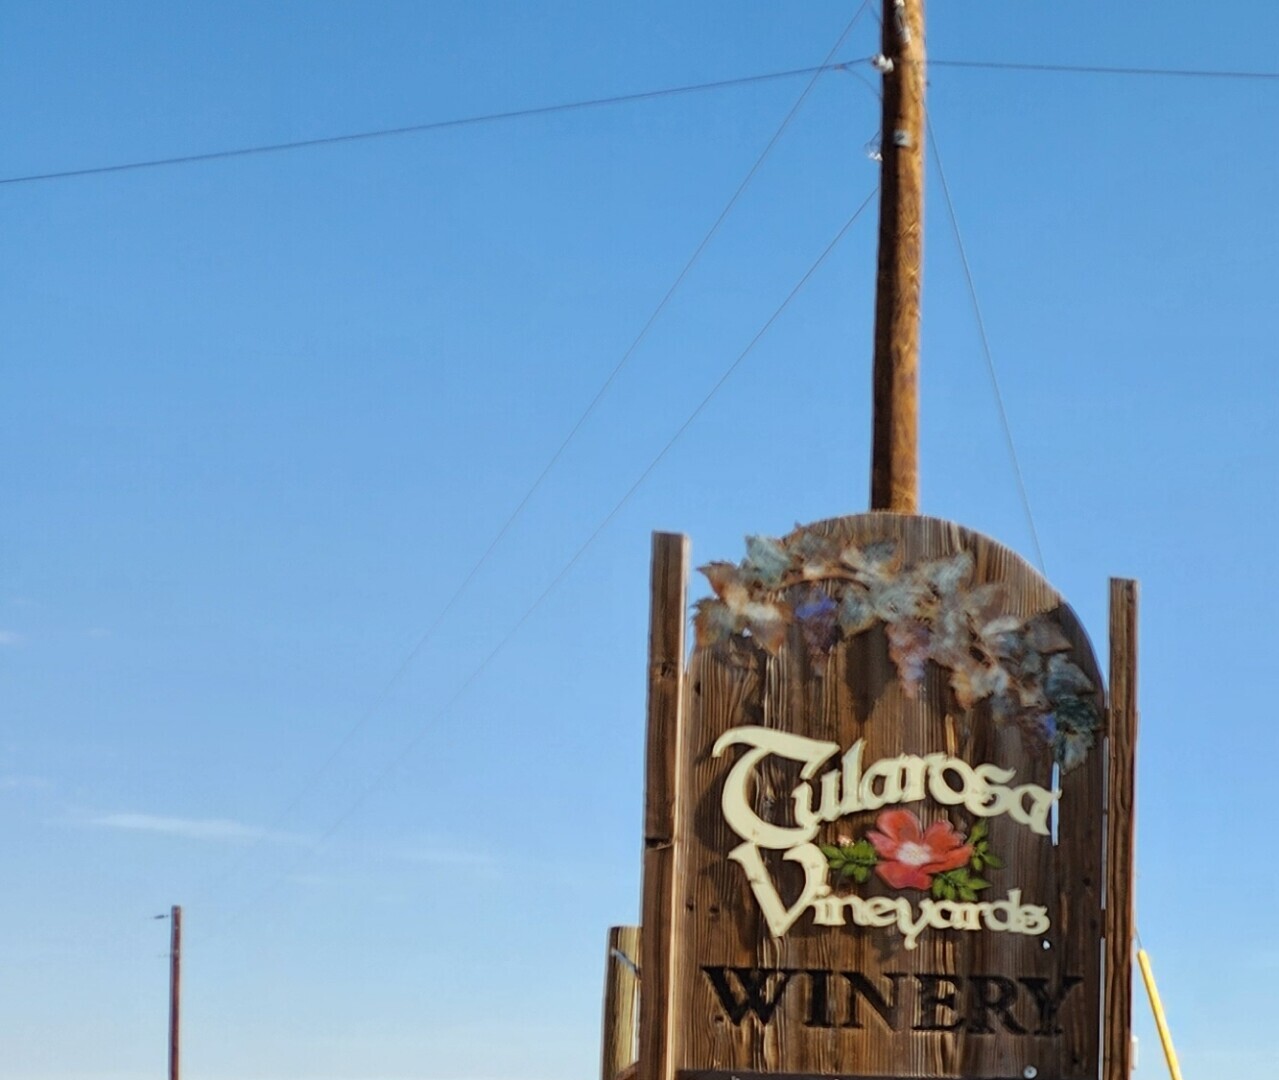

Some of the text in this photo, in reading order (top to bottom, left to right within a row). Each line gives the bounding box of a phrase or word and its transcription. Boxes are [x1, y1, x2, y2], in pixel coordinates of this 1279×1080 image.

[711, 726, 1062, 848] Tularosa
[727, 841, 1050, 950] Vineyards
[702, 965, 1084, 1035] WINERY
